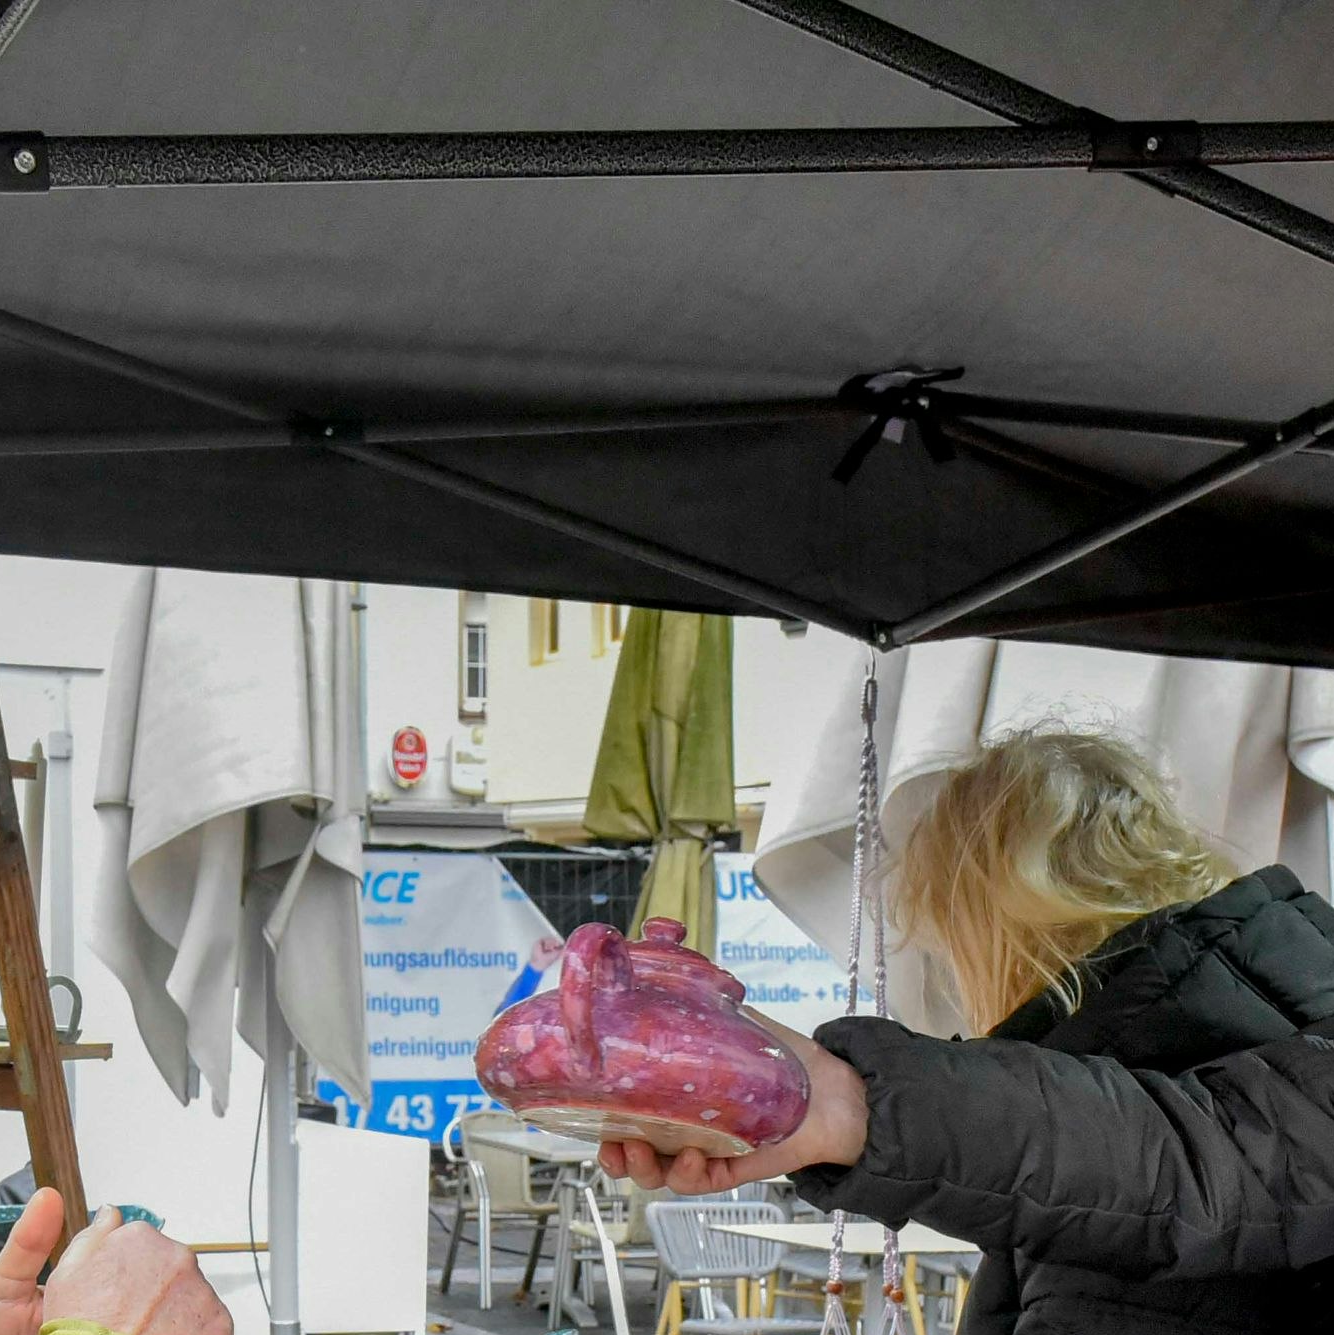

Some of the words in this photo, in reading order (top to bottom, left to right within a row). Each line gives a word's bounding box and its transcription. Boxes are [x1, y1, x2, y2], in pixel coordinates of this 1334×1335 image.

[366, 992, 440, 1016] inigung
[368, 1037, 476, 1061] elreinigun
[385, 1094, 436, 1132] 43
